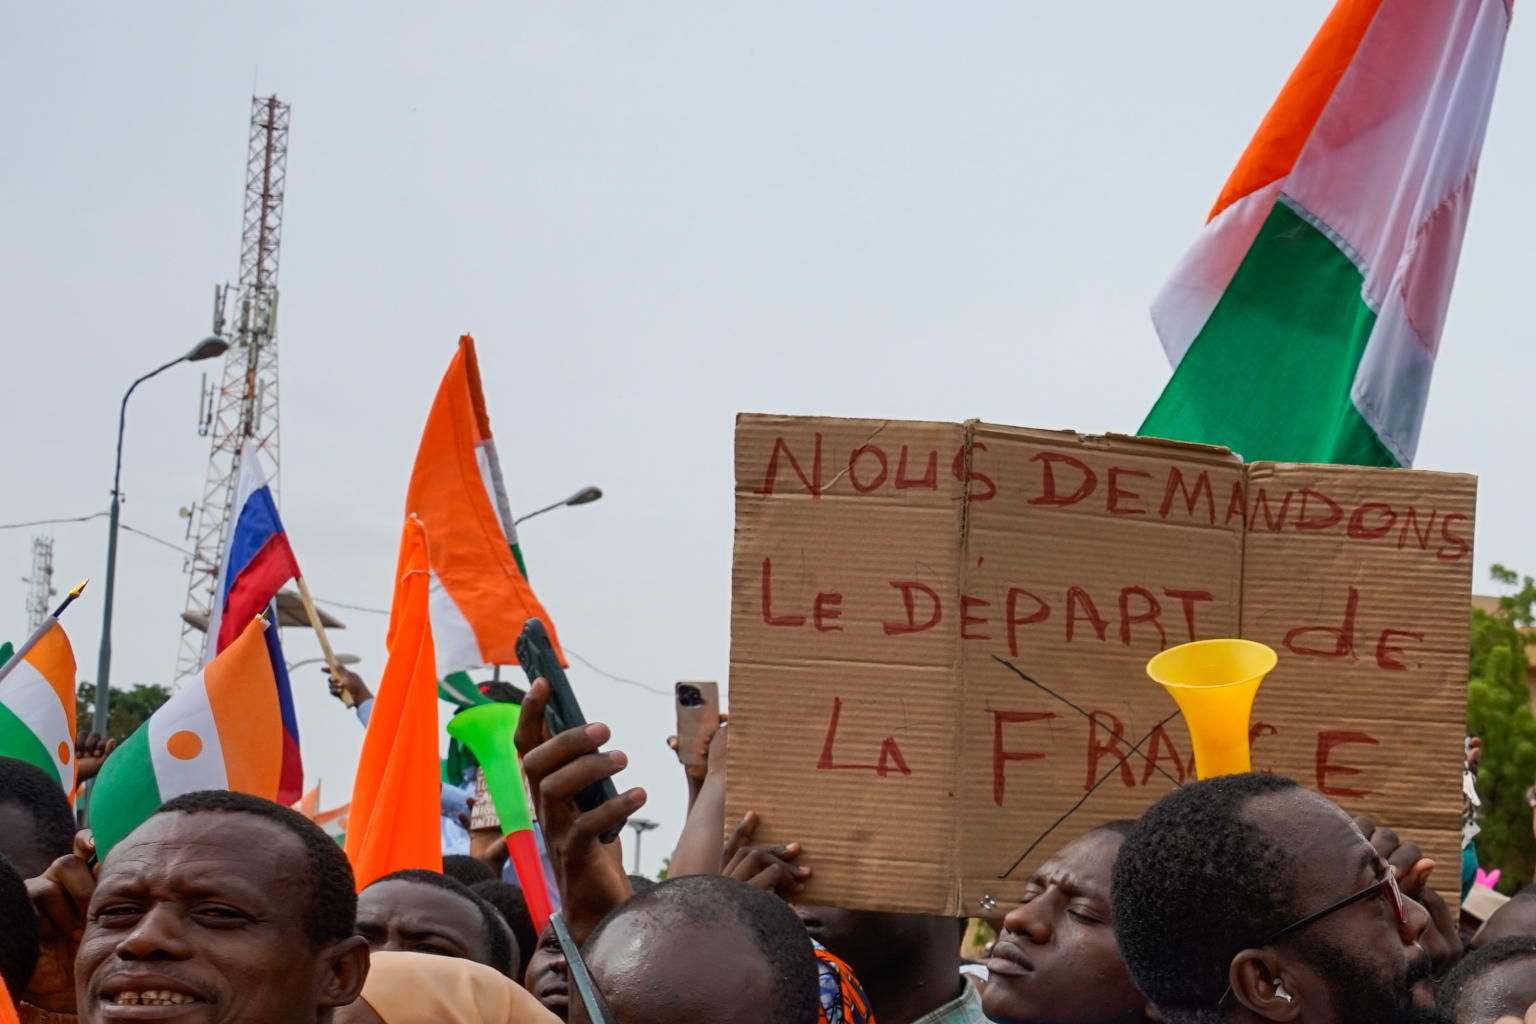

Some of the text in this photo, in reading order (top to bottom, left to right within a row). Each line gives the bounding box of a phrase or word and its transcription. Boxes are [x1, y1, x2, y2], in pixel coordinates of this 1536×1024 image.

[755, 433, 1469, 560] NOUS DEMANDONS
[986, 710, 1380, 806] FRACE
